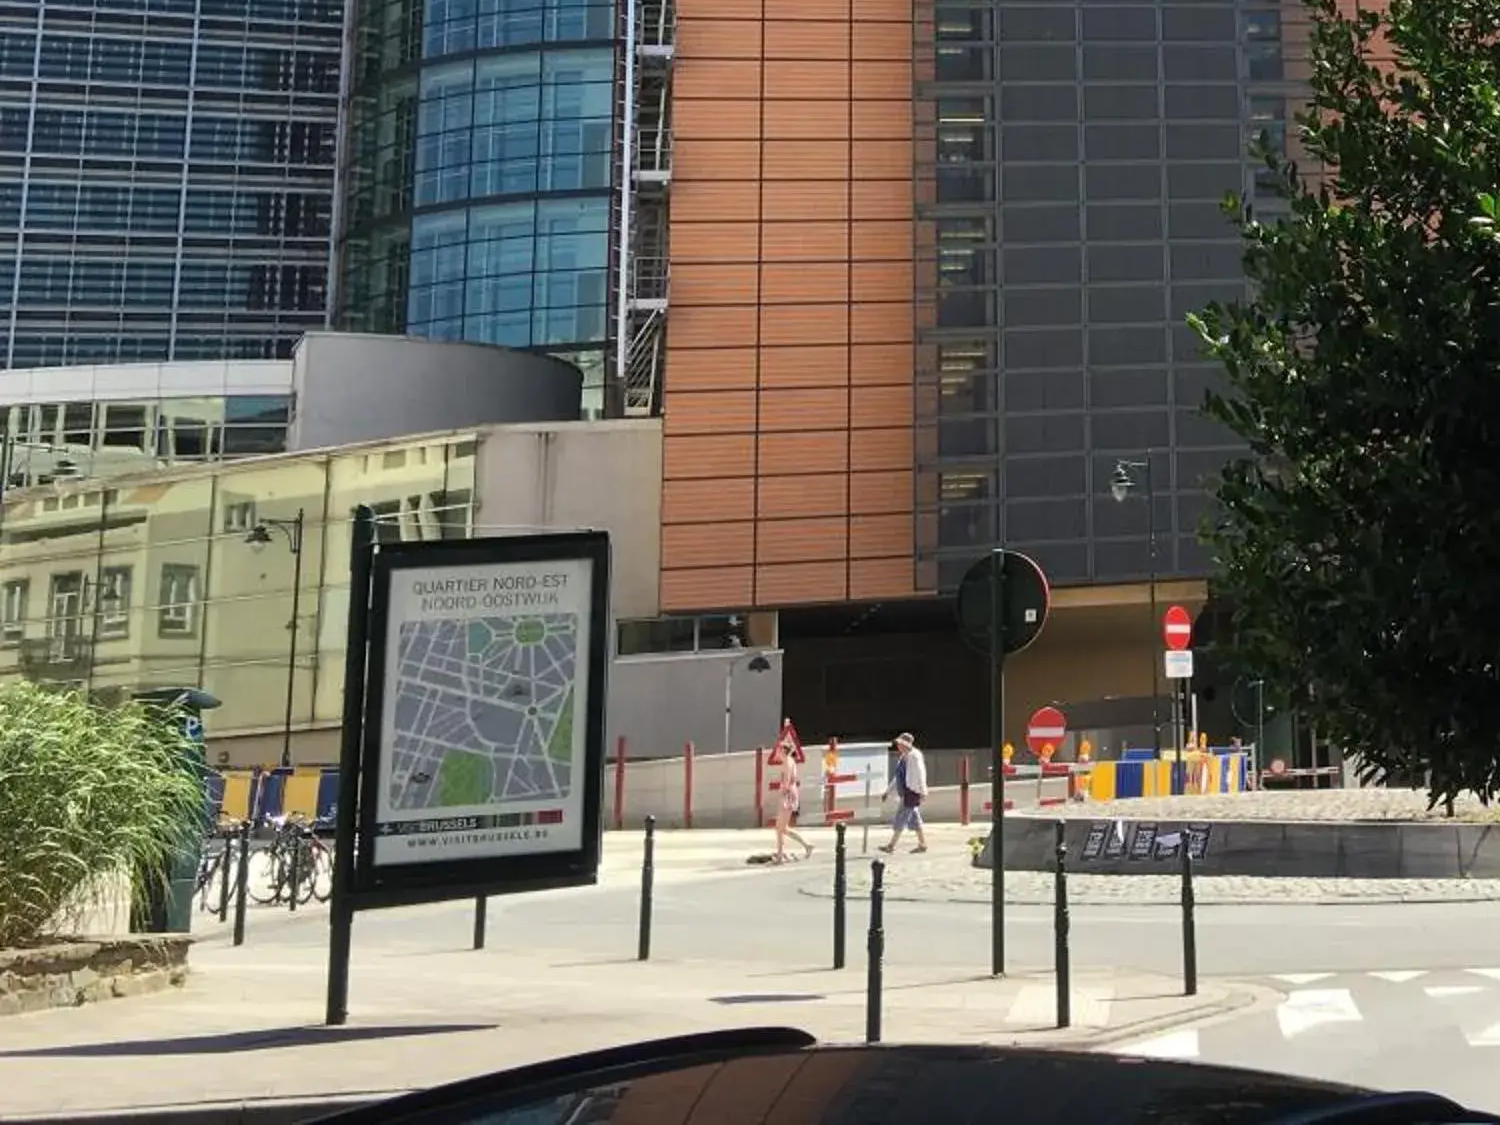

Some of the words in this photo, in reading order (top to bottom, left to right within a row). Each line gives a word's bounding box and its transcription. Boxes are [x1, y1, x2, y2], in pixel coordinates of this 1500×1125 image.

[413, 578, 487, 595] QUARTIER
[493, 574, 568, 591] NORD-EST
[421, 592, 558, 611] NOORD-OOSTWIJK
